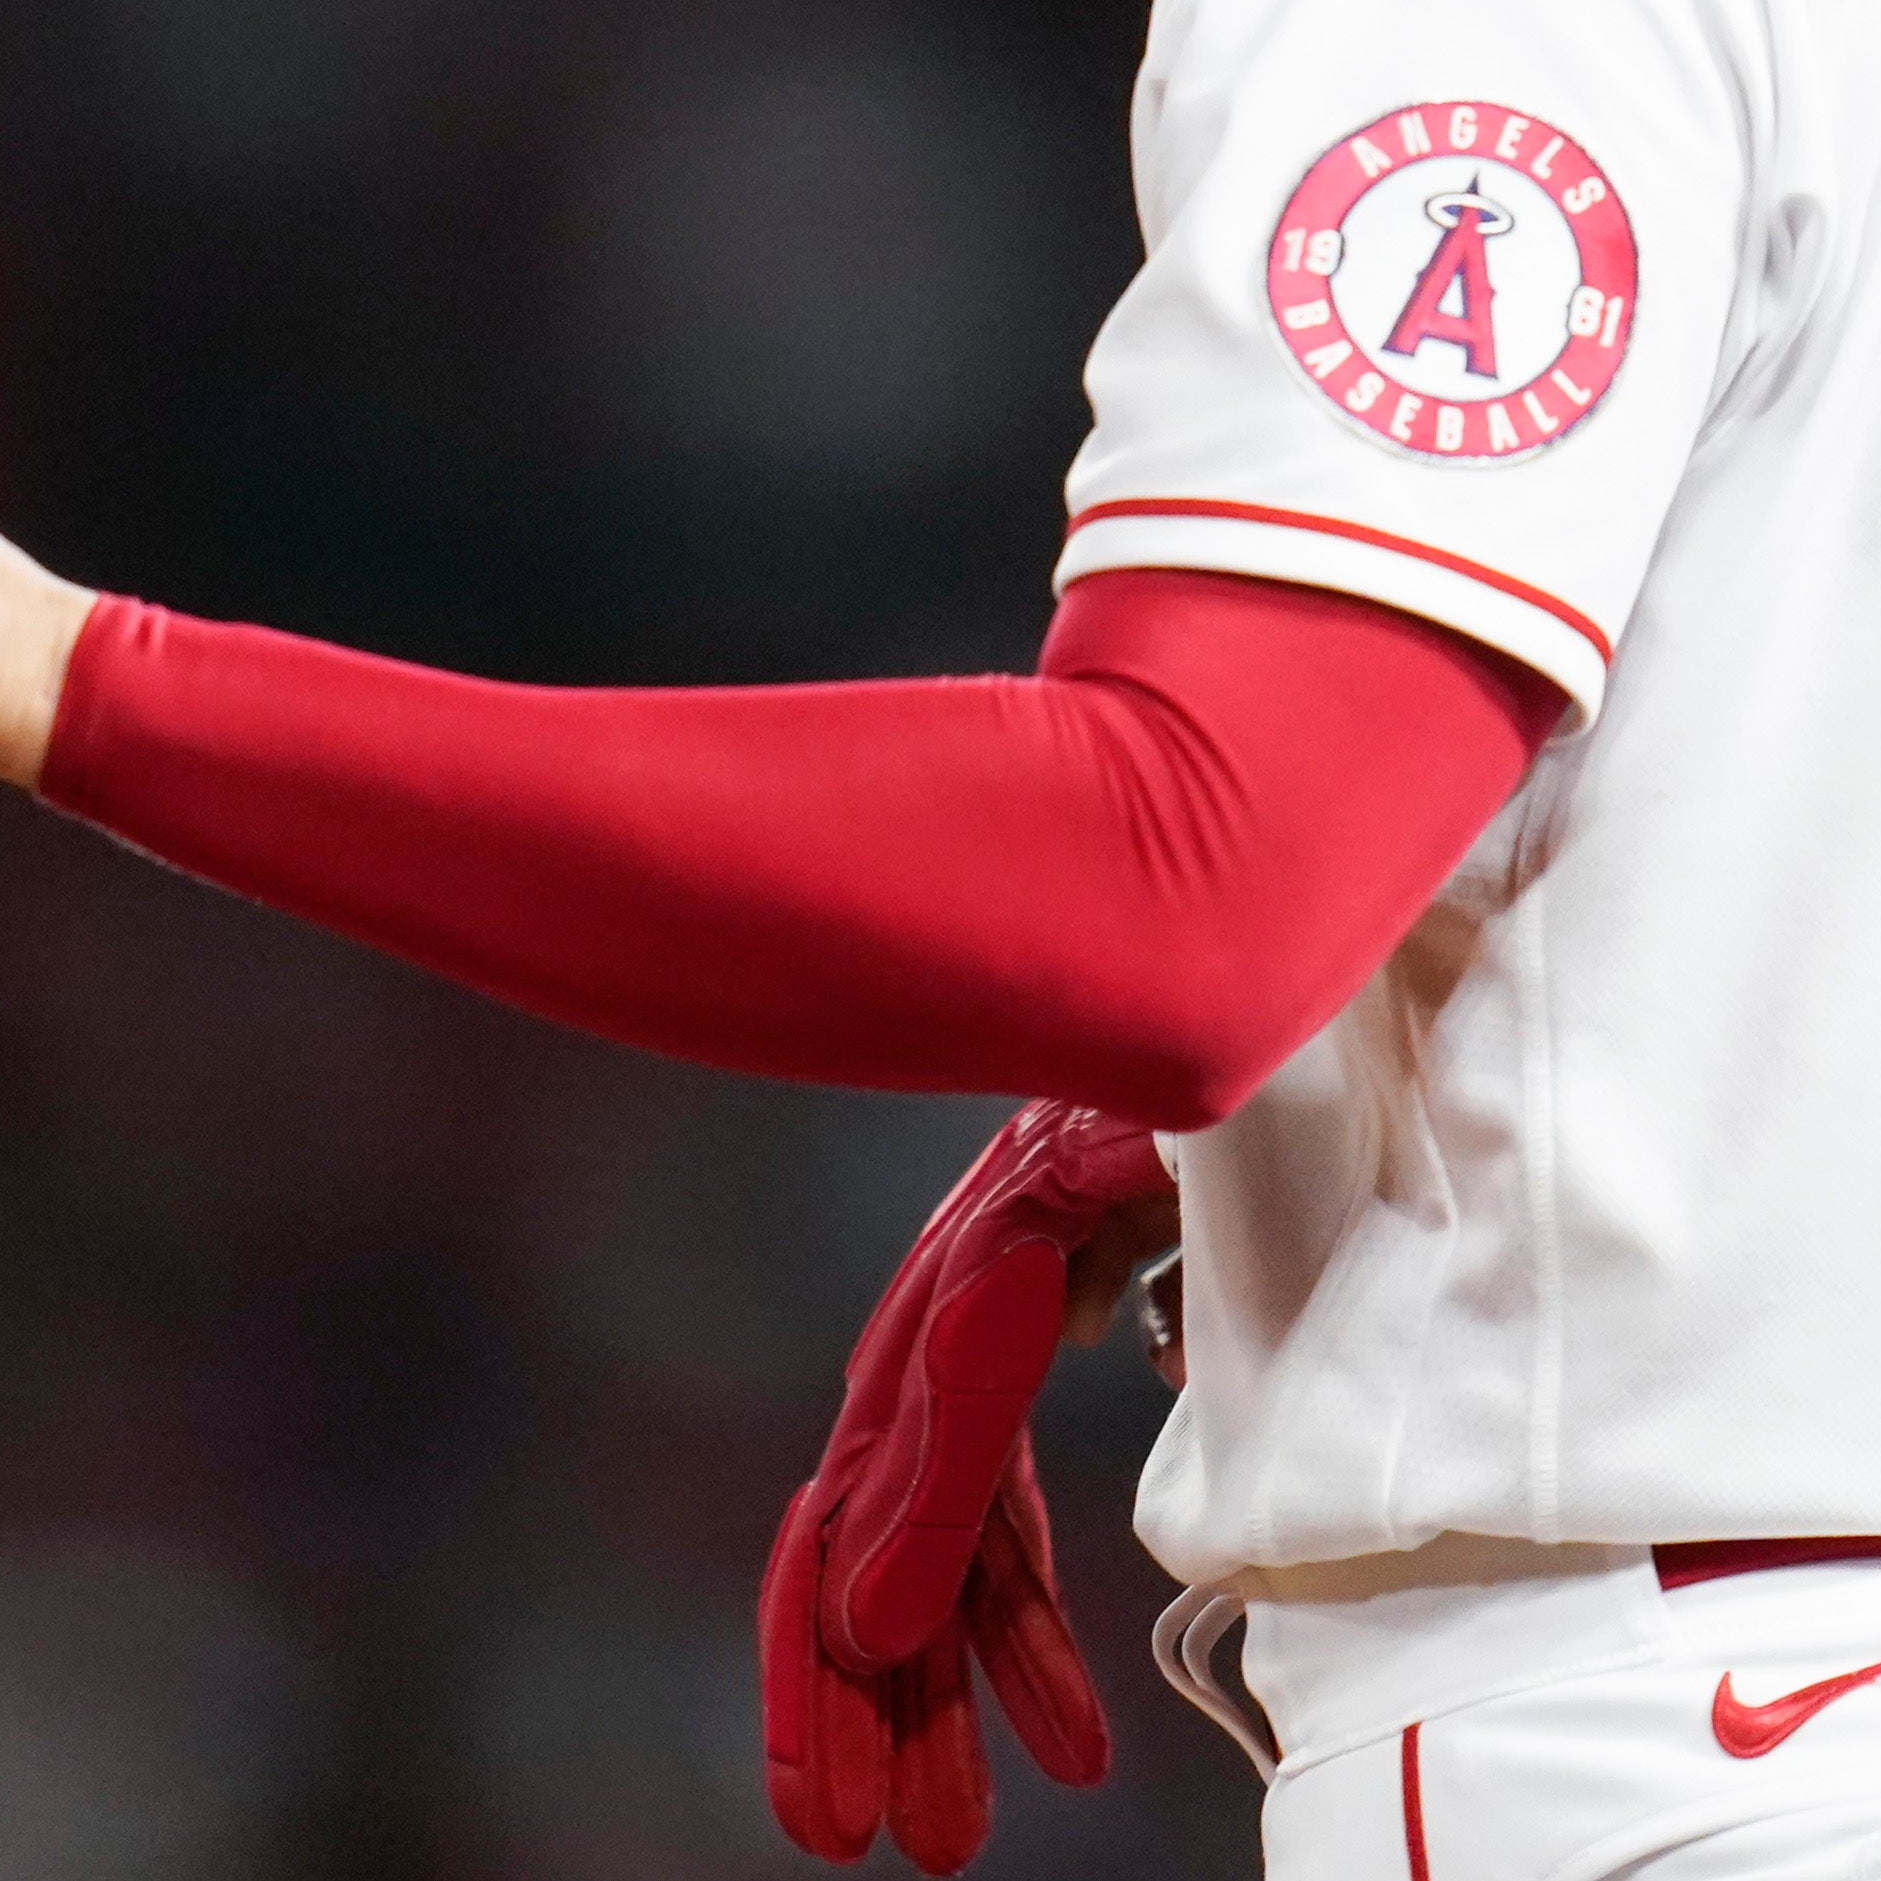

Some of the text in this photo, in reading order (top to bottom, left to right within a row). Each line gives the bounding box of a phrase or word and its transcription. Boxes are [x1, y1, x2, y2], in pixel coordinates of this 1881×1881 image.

[1349, 105, 1607, 214] ANGELS
[1281, 227, 1343, 277] 19
[1568, 284, 1624, 348] 61
[1282, 298, 1592, 453] BASEBALL
